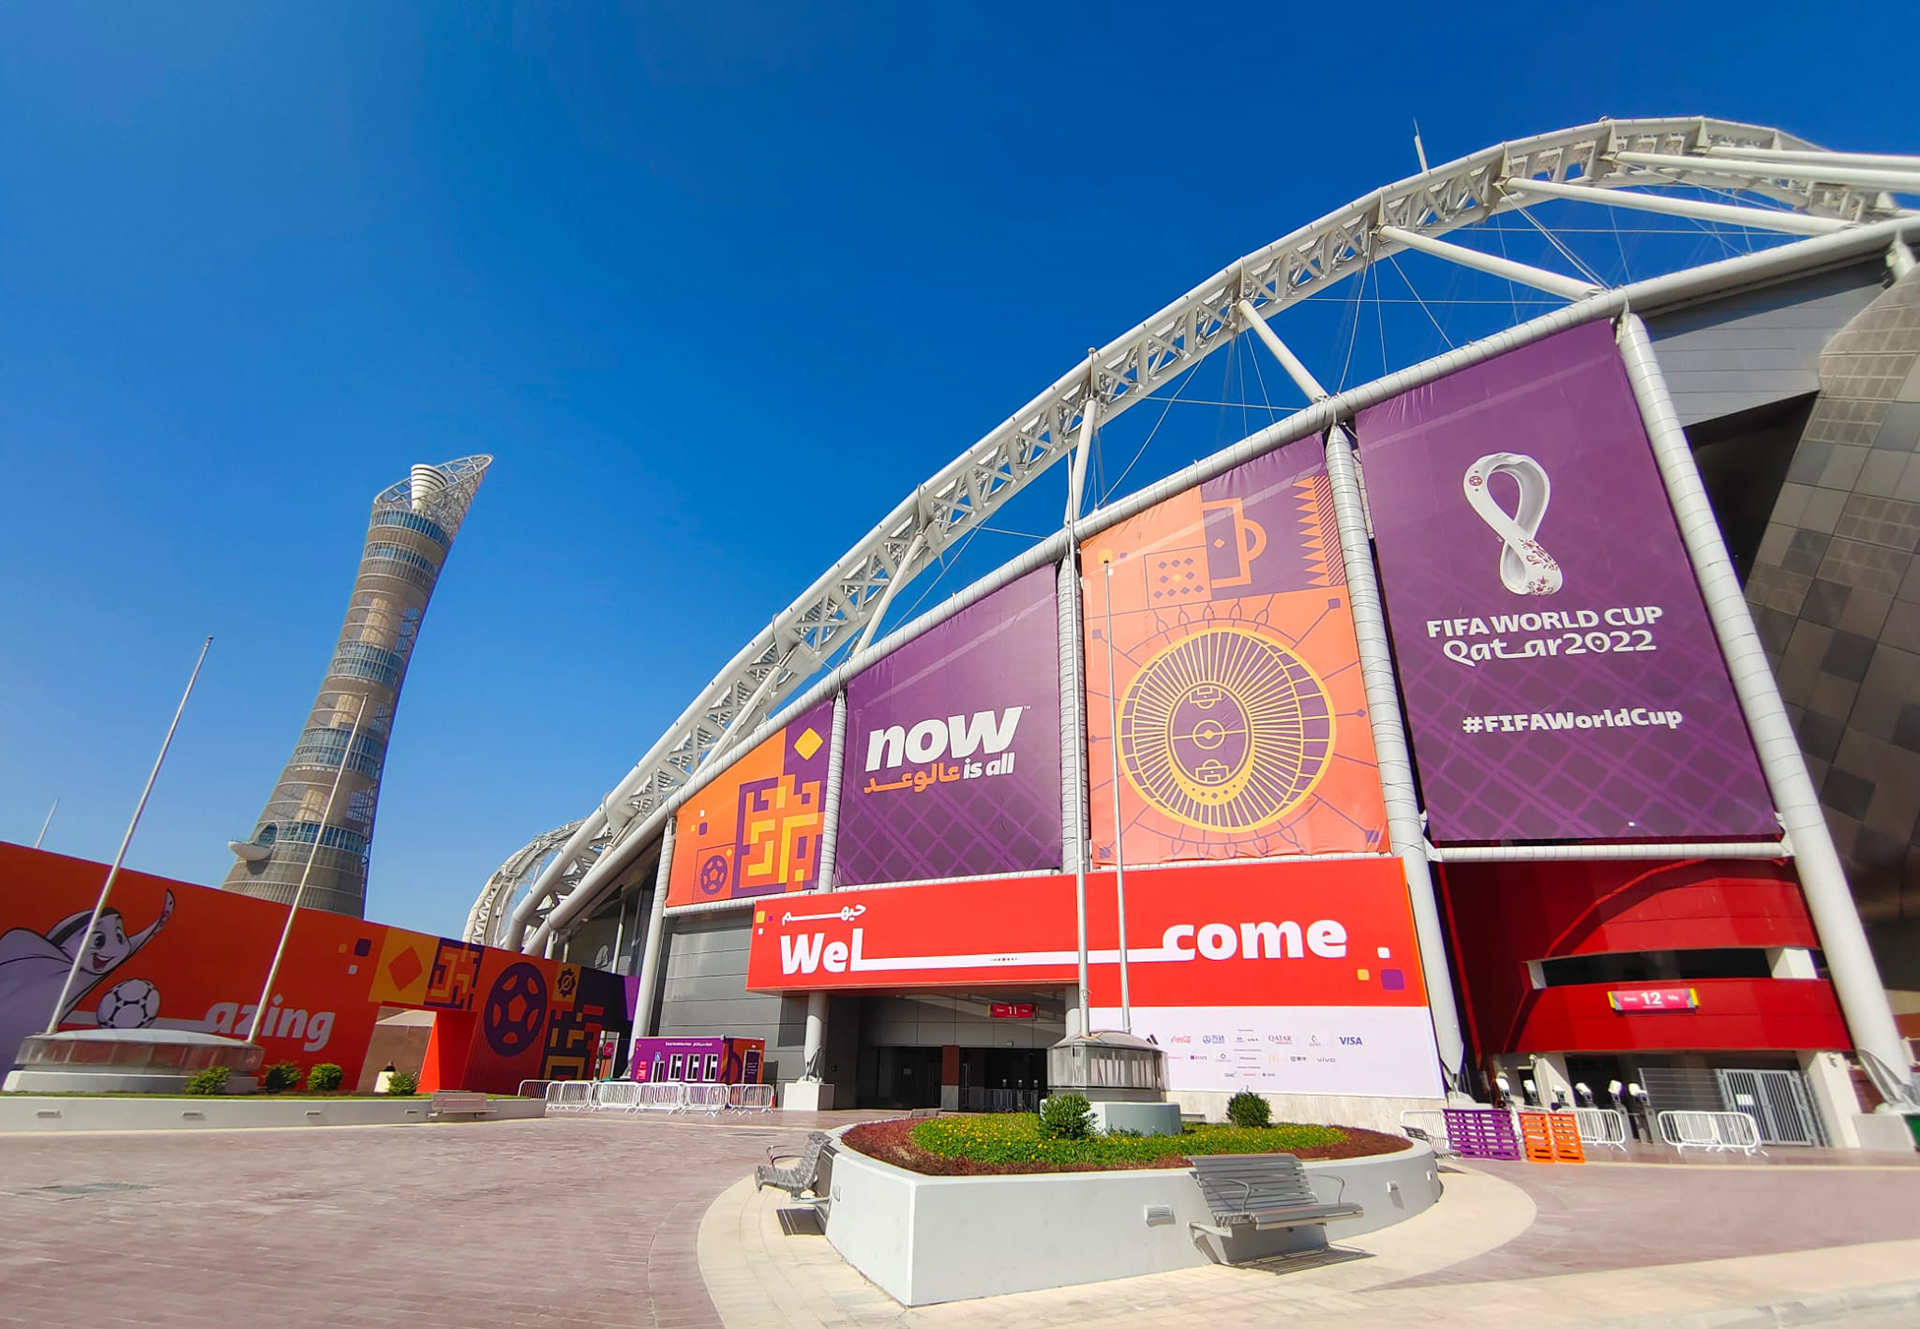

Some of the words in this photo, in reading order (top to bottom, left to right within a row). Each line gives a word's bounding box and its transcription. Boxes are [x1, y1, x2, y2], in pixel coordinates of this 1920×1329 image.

[1426, 618, 1489, 638] FIFA
[1490, 610, 1599, 634] WORLD
[1603, 606, 1663, 627] CUP
[1462, 707, 1683, 734] #FIFAWorldCup
[865, 706, 1023, 772] now
[963, 758, 983, 780] is
[986, 752, 1015, 777] all
[1162, 919, 1348, 962] come
[1008, 1005, 1018, 1015] 11
[1641, 991, 1663, 1005] 12
[1338, 1036, 1363, 1046] VISA
